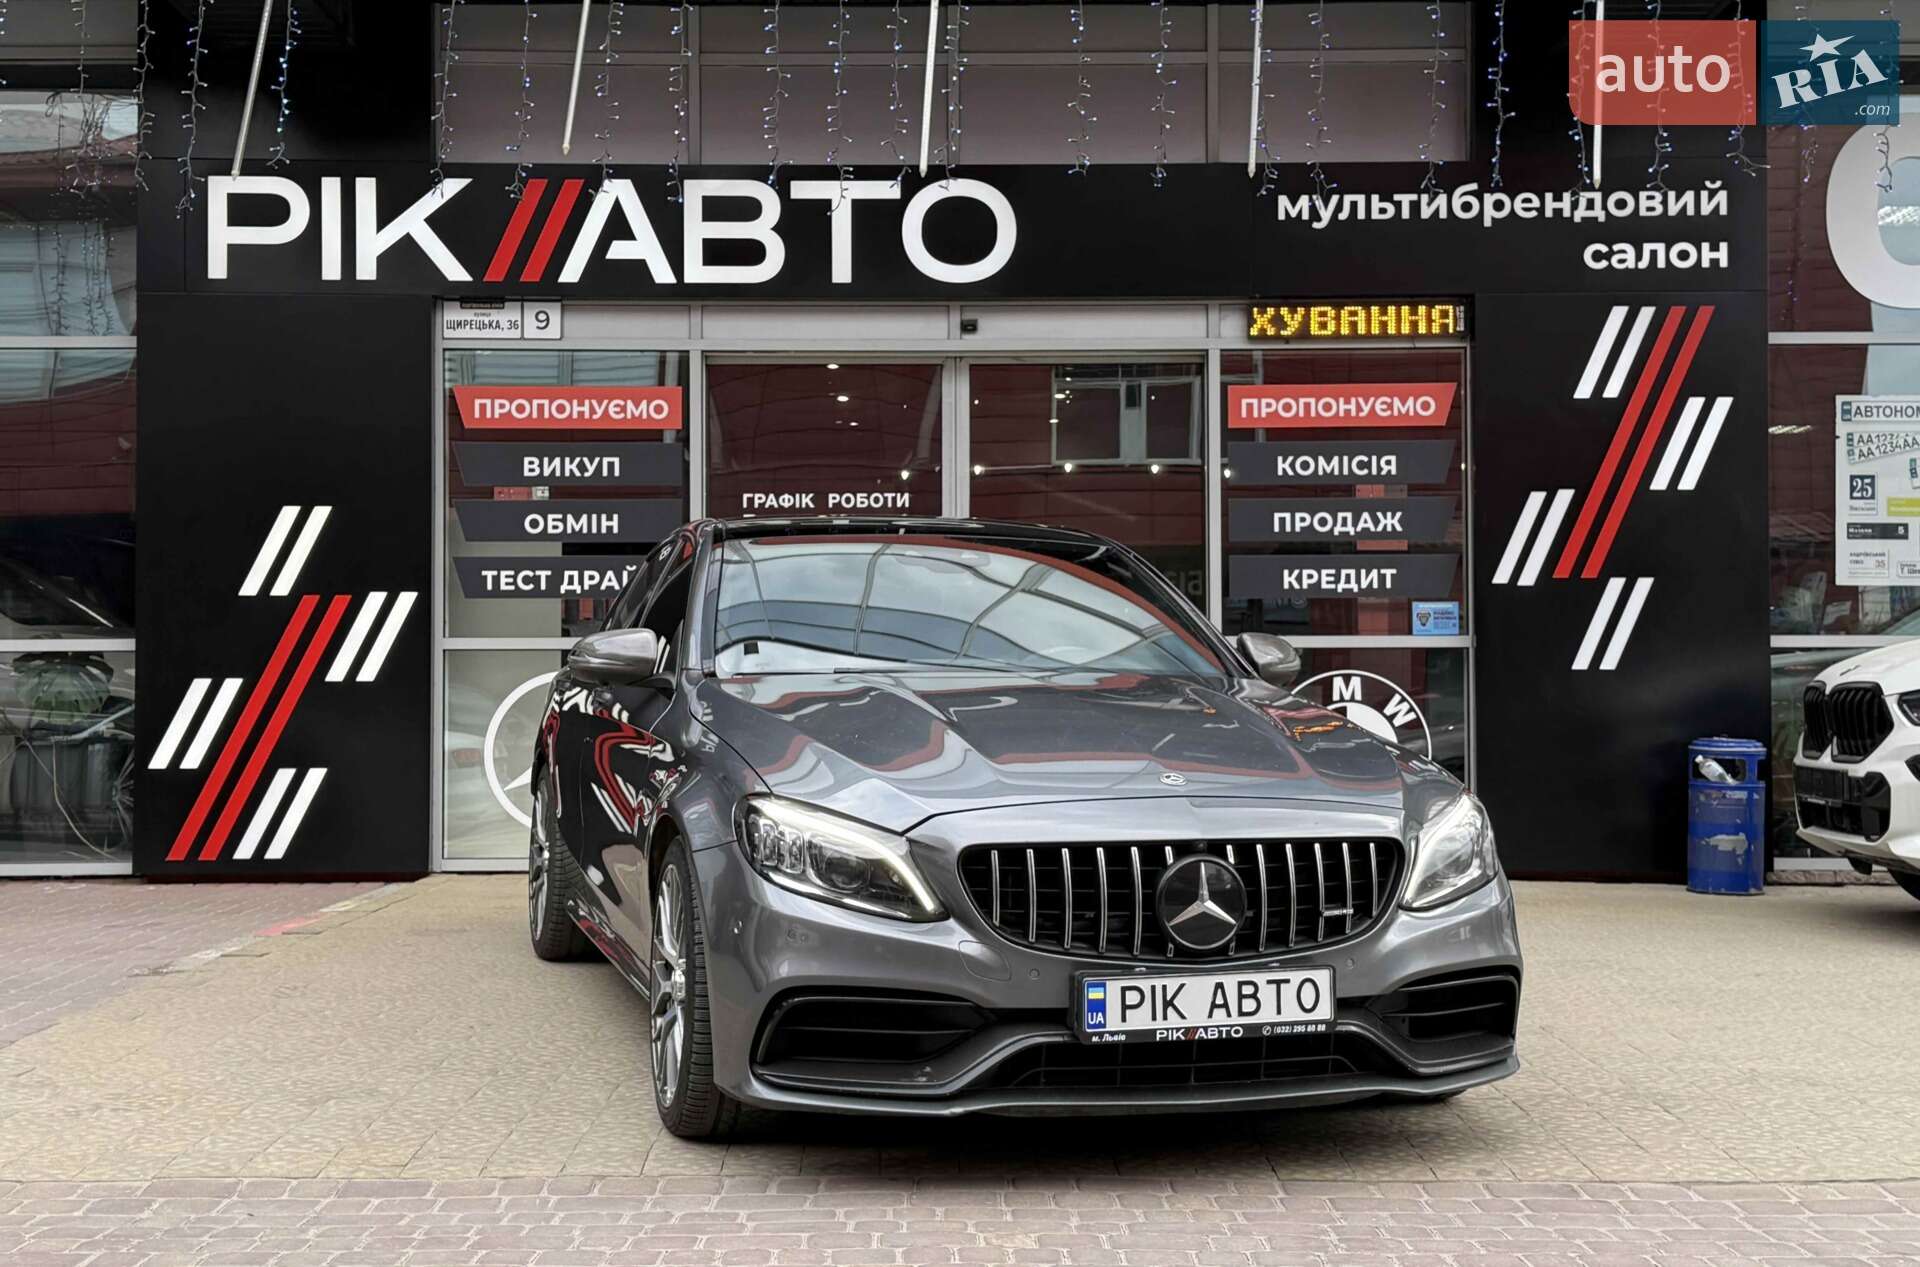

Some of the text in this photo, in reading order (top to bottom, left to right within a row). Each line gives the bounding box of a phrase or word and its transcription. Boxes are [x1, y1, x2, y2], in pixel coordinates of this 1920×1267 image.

[1277, 181, 1729, 229] мультибрендовий
[1583, 241, 1729, 270] салон
[446, 319, 520, 332] ЩИРЕЦЬКА, 36
[534, 310, 550, 330] 9
[474, 398, 670, 420] ПРОПОНУЄМО
[1240, 395, 1436, 419] ПРОПОНУЄМО
[523, 456, 620, 478] ВИКУП
[1276, 454, 1397, 476] КОМІСІЯ
[1852, 478, 1872, 497] 25
[742, 493, 910, 509] ГРАФІК РОБОТИ
[523, 513, 619, 535] ОБМІН
[1273, 511, 1403, 536] ПРОДАЖ
[481, 569, 552, 591] ТЕСТ
[1282, 568, 1398, 593] КРЕДИТ
[1119, 977, 1321, 1023] РІК АВТО
[1088, 1012, 1104, 1025] UA
